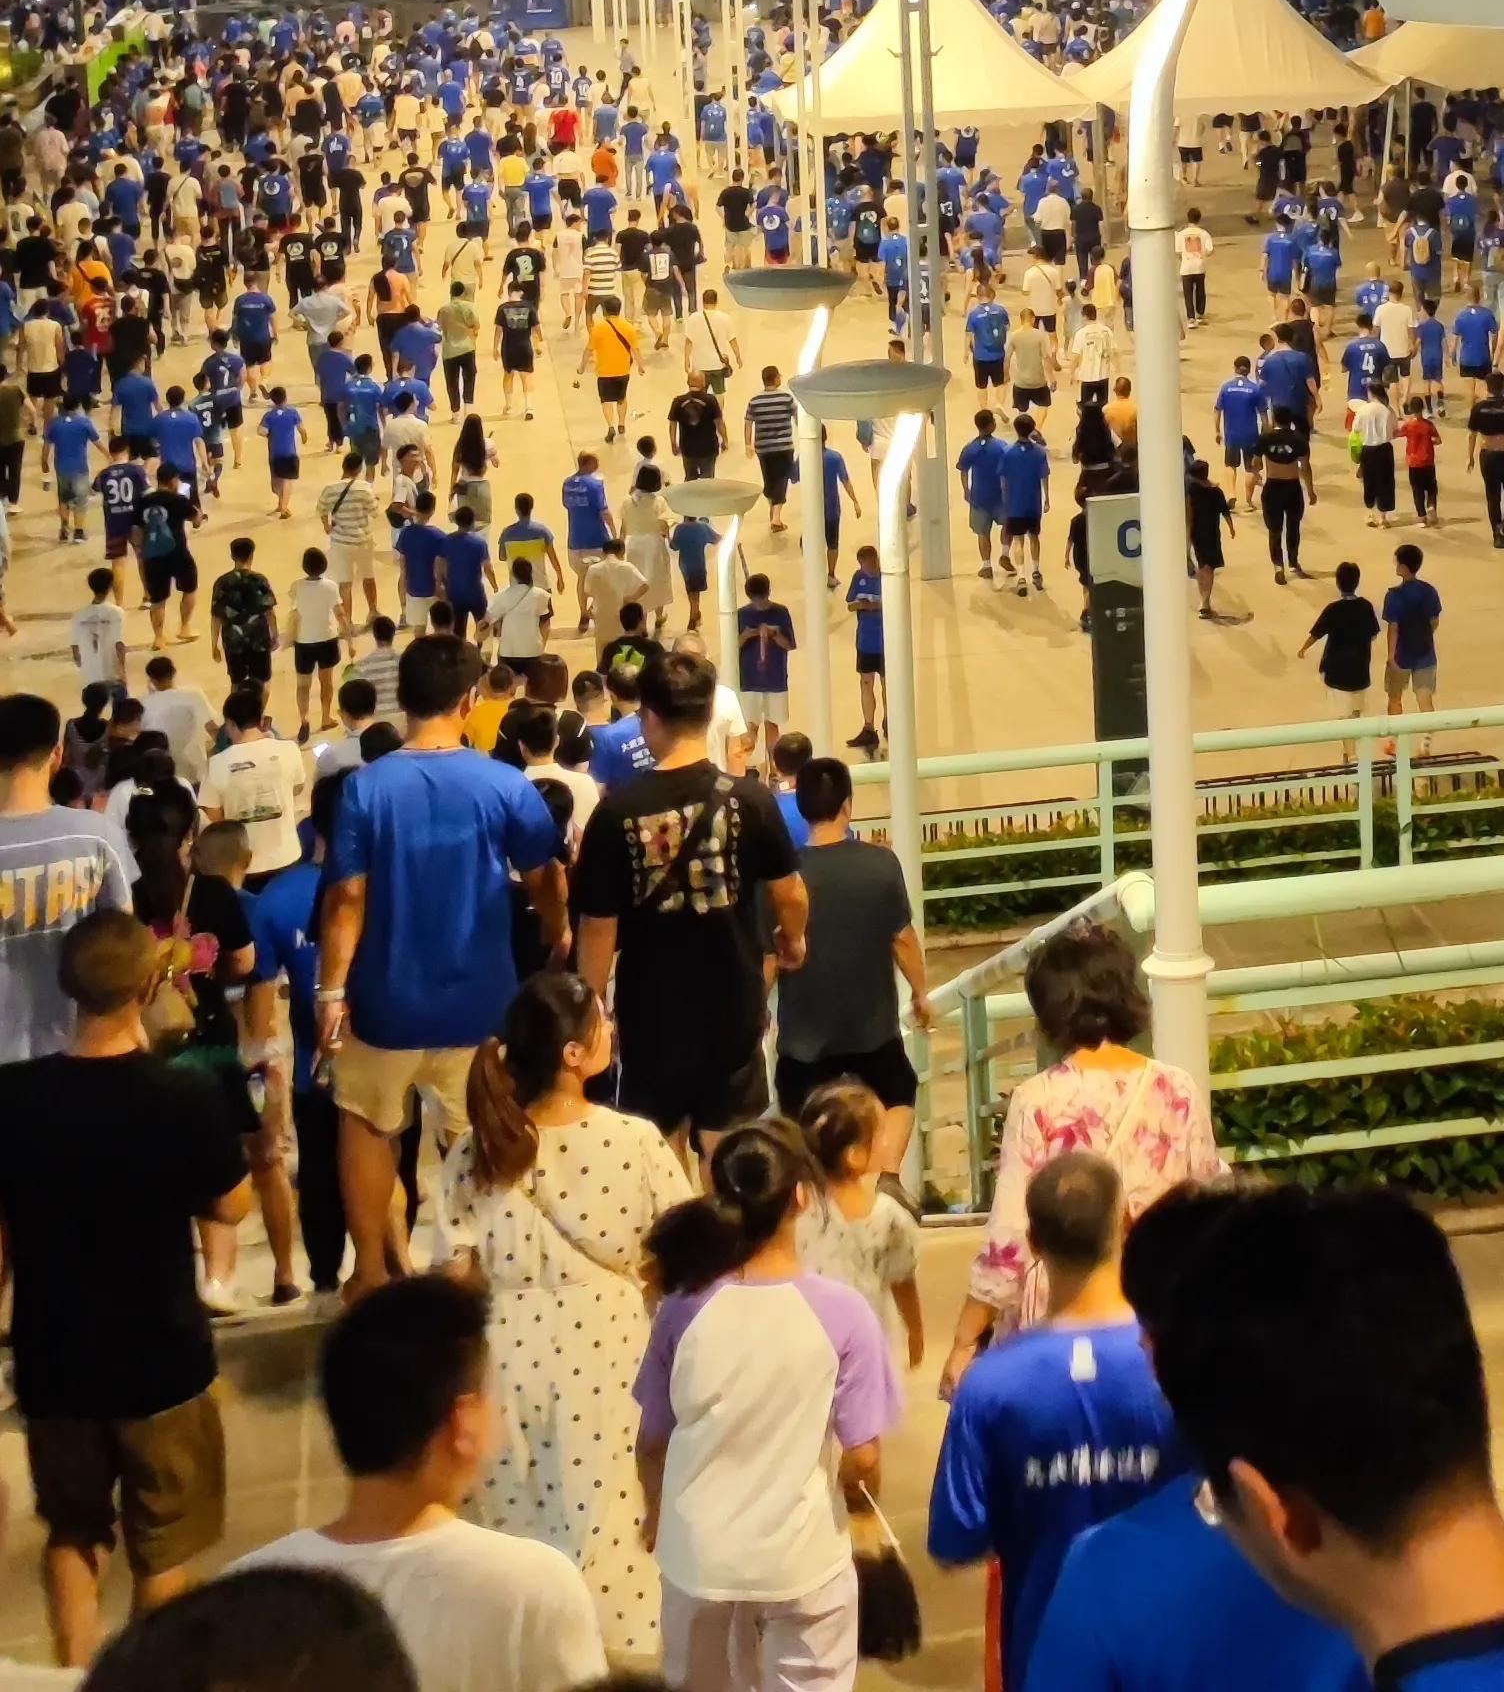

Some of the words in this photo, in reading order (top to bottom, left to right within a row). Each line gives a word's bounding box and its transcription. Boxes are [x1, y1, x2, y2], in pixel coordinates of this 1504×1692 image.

[549, 70, 562, 86] 10
[1362, 352, 1375, 375] 4
[106, 477, 134, 504] 30
